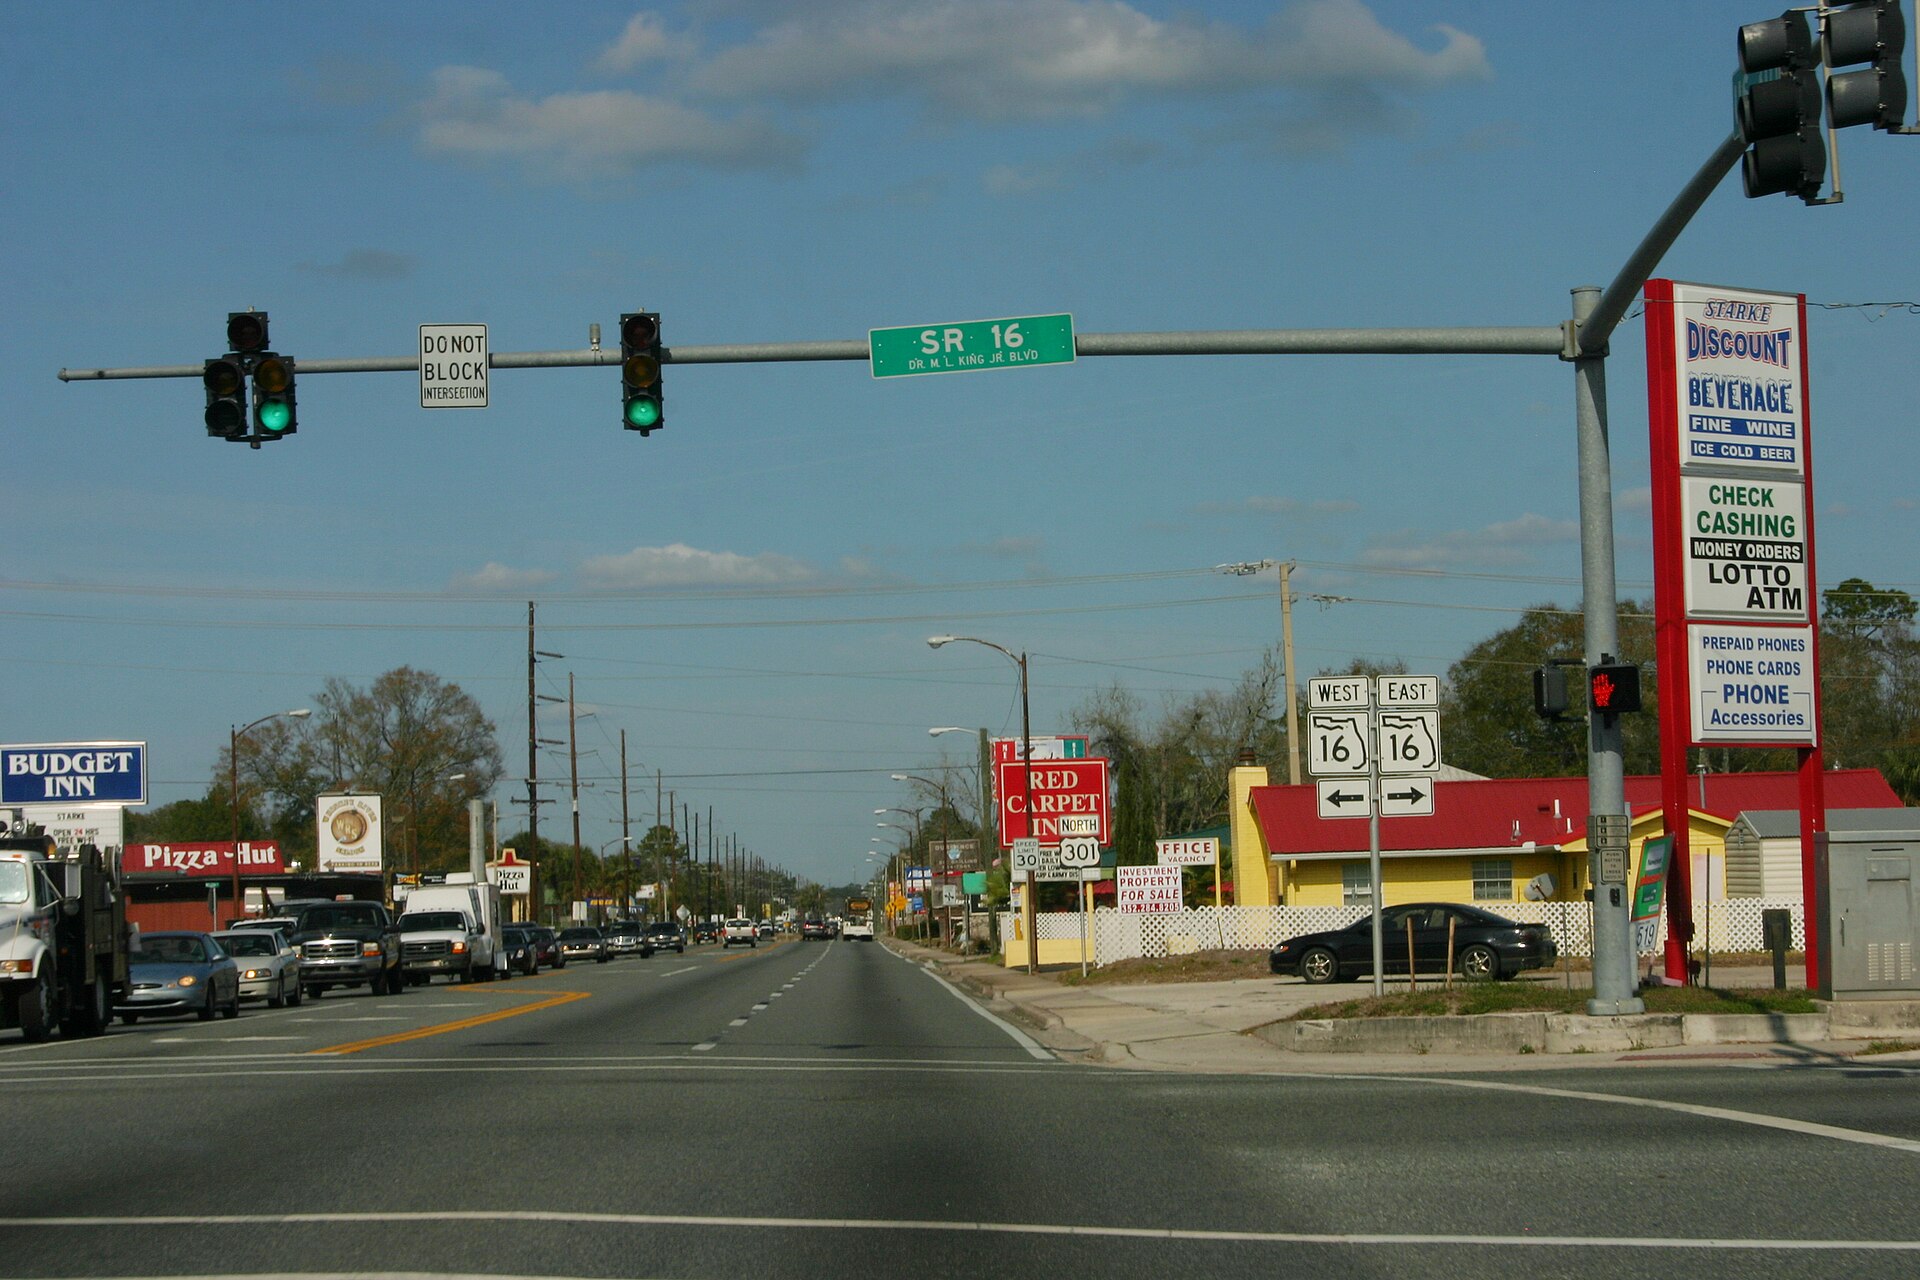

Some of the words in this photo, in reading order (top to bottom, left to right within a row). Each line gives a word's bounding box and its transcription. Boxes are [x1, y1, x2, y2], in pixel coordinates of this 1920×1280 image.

[1704, 298, 1772, 325] STARKE
[424, 336, 447, 354] DO
[452, 335, 484, 353] NOT
[920, 328, 964, 354] SR
[991, 323, 1024, 349] 16
[1686, 318, 1792, 369] DISCOUNT
[959, 354, 985, 366] KING
[1010, 350, 1038, 362] BLVD
[425, 362, 484, 380] BLOCK
[424, 387, 485, 399] INTERSECTION
[1688, 371, 1793, 414] BEVERAGE
[1692, 417, 1732, 433] FINE
[1746, 420, 1792, 437] WINE
[1694, 443, 1714, 455] ICE
[1721, 445, 1753, 458] COLD
[1760, 448, 1792, 460] BEER
[1709, 485, 1774, 507] CHECK
[1697, 511, 1795, 538] CASHING
[1694, 542, 1742, 558] MONEY
[1746, 543, 1800, 560] ORDERS
[1709, 563, 1790, 587] LOTTO
[1747, 587, 1802, 610] ATM
[1703, 636, 1753, 651] PREPAID
[1758, 638, 1805, 652] PHONES
[1707, 660, 1753, 675] PHONE
[1758, 661, 1800, 676] CARDS
[1318, 684, 1359, 702] WEST
[1389, 683, 1427, 700] EAST
[1723, 684, 1789, 704] PHONE
[1711, 709, 1804, 726] Accessories
[1320, 735, 1350, 762] 16
[1390, 734, 1420, 761] 16
[8, 752, 133, 775] BUDGET
[44, 776, 96, 797] INN
[1030, 771, 1078, 790] RED
[1032, 818, 1058, 836] IN
[1062, 819, 1097, 835] NORTH
[144, 844, 218, 869] Pizza
[224, 842, 276, 865] Hut
[1065, 843, 1095, 861] 301
[1156, 842, 1211, 854] FFICE
[1017, 855, 1036, 866] 30
[1168, 855, 1206, 863] VACANCY
[496, 870, 524, 881] Pizza
[1119, 867, 1179, 876] INVESTMENT
[500, 880, 518, 890] Hut
[1120, 876, 1179, 887] PROPERTY
[1121, 890, 1144, 900] FOR
[1150, 889, 1179, 899] SALE
